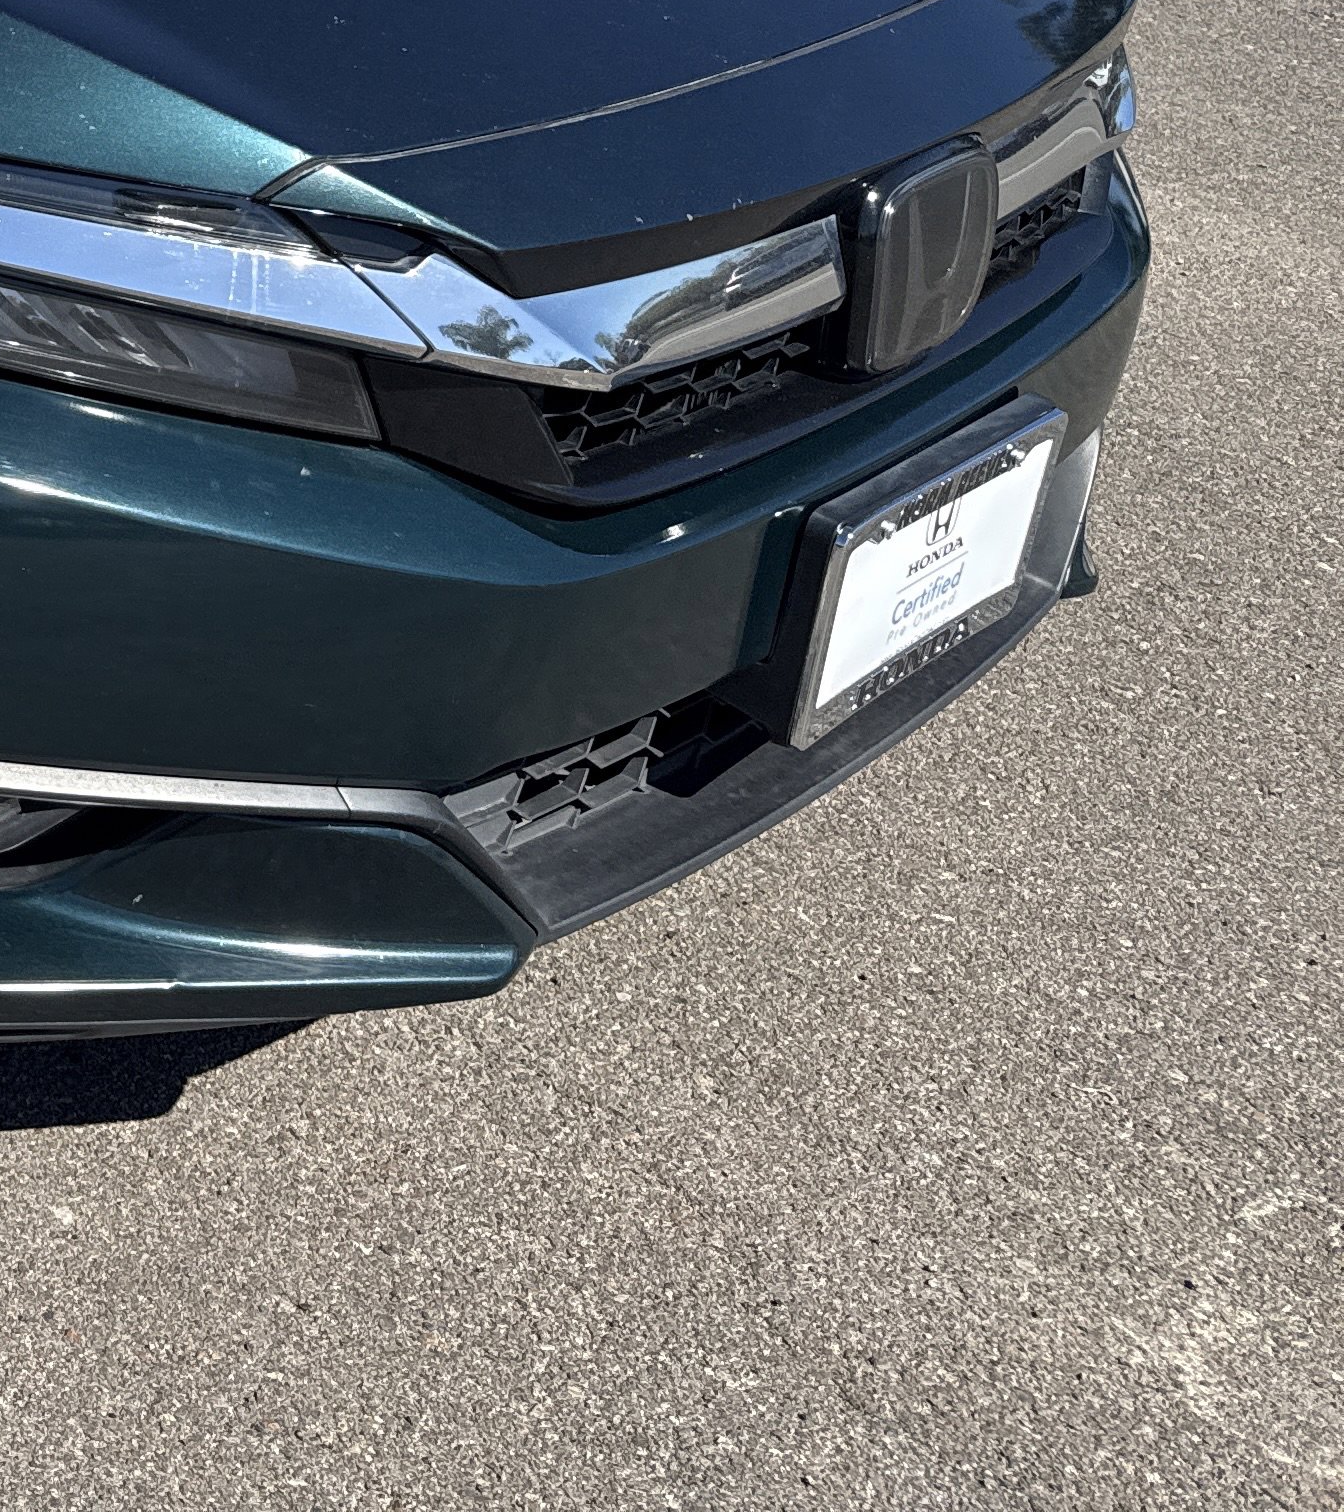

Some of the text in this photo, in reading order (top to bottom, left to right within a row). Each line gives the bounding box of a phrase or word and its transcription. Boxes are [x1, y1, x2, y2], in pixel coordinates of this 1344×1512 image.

[906, 537, 964, 578] HONDA
[886, 590, 958, 645] Pre Owned
[891, 561, 965, 626] Certified
